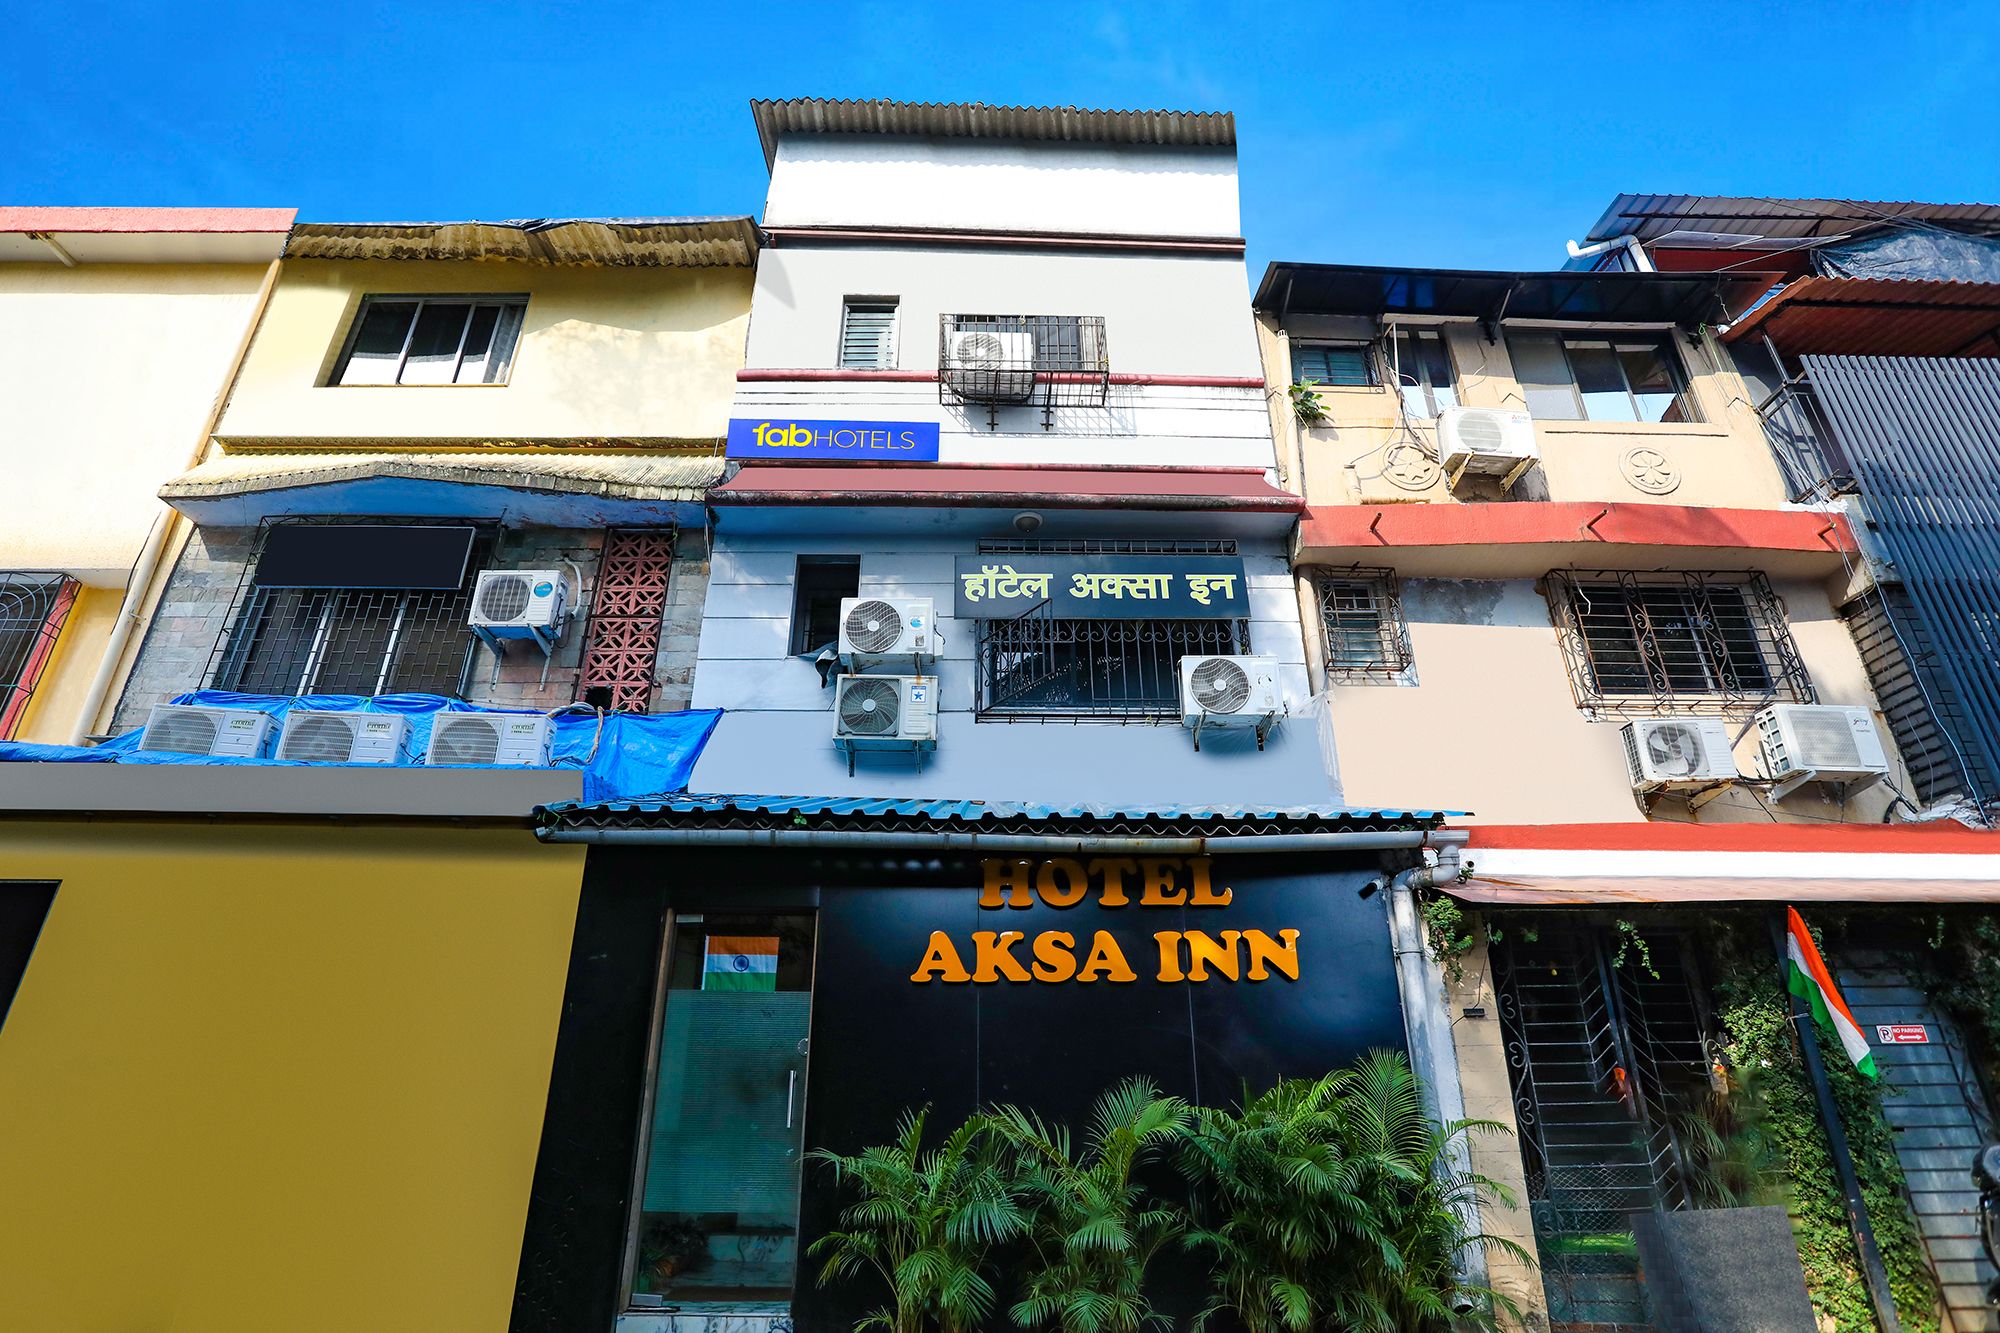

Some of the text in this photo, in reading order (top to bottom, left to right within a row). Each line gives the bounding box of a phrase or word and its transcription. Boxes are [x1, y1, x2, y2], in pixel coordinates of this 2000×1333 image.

[961, 565, 1237, 605] हॉटेल अक्सा इन
[978, 857, 1233, 907] HOTEL
[910, 928, 1300, 982] AKSA INN
